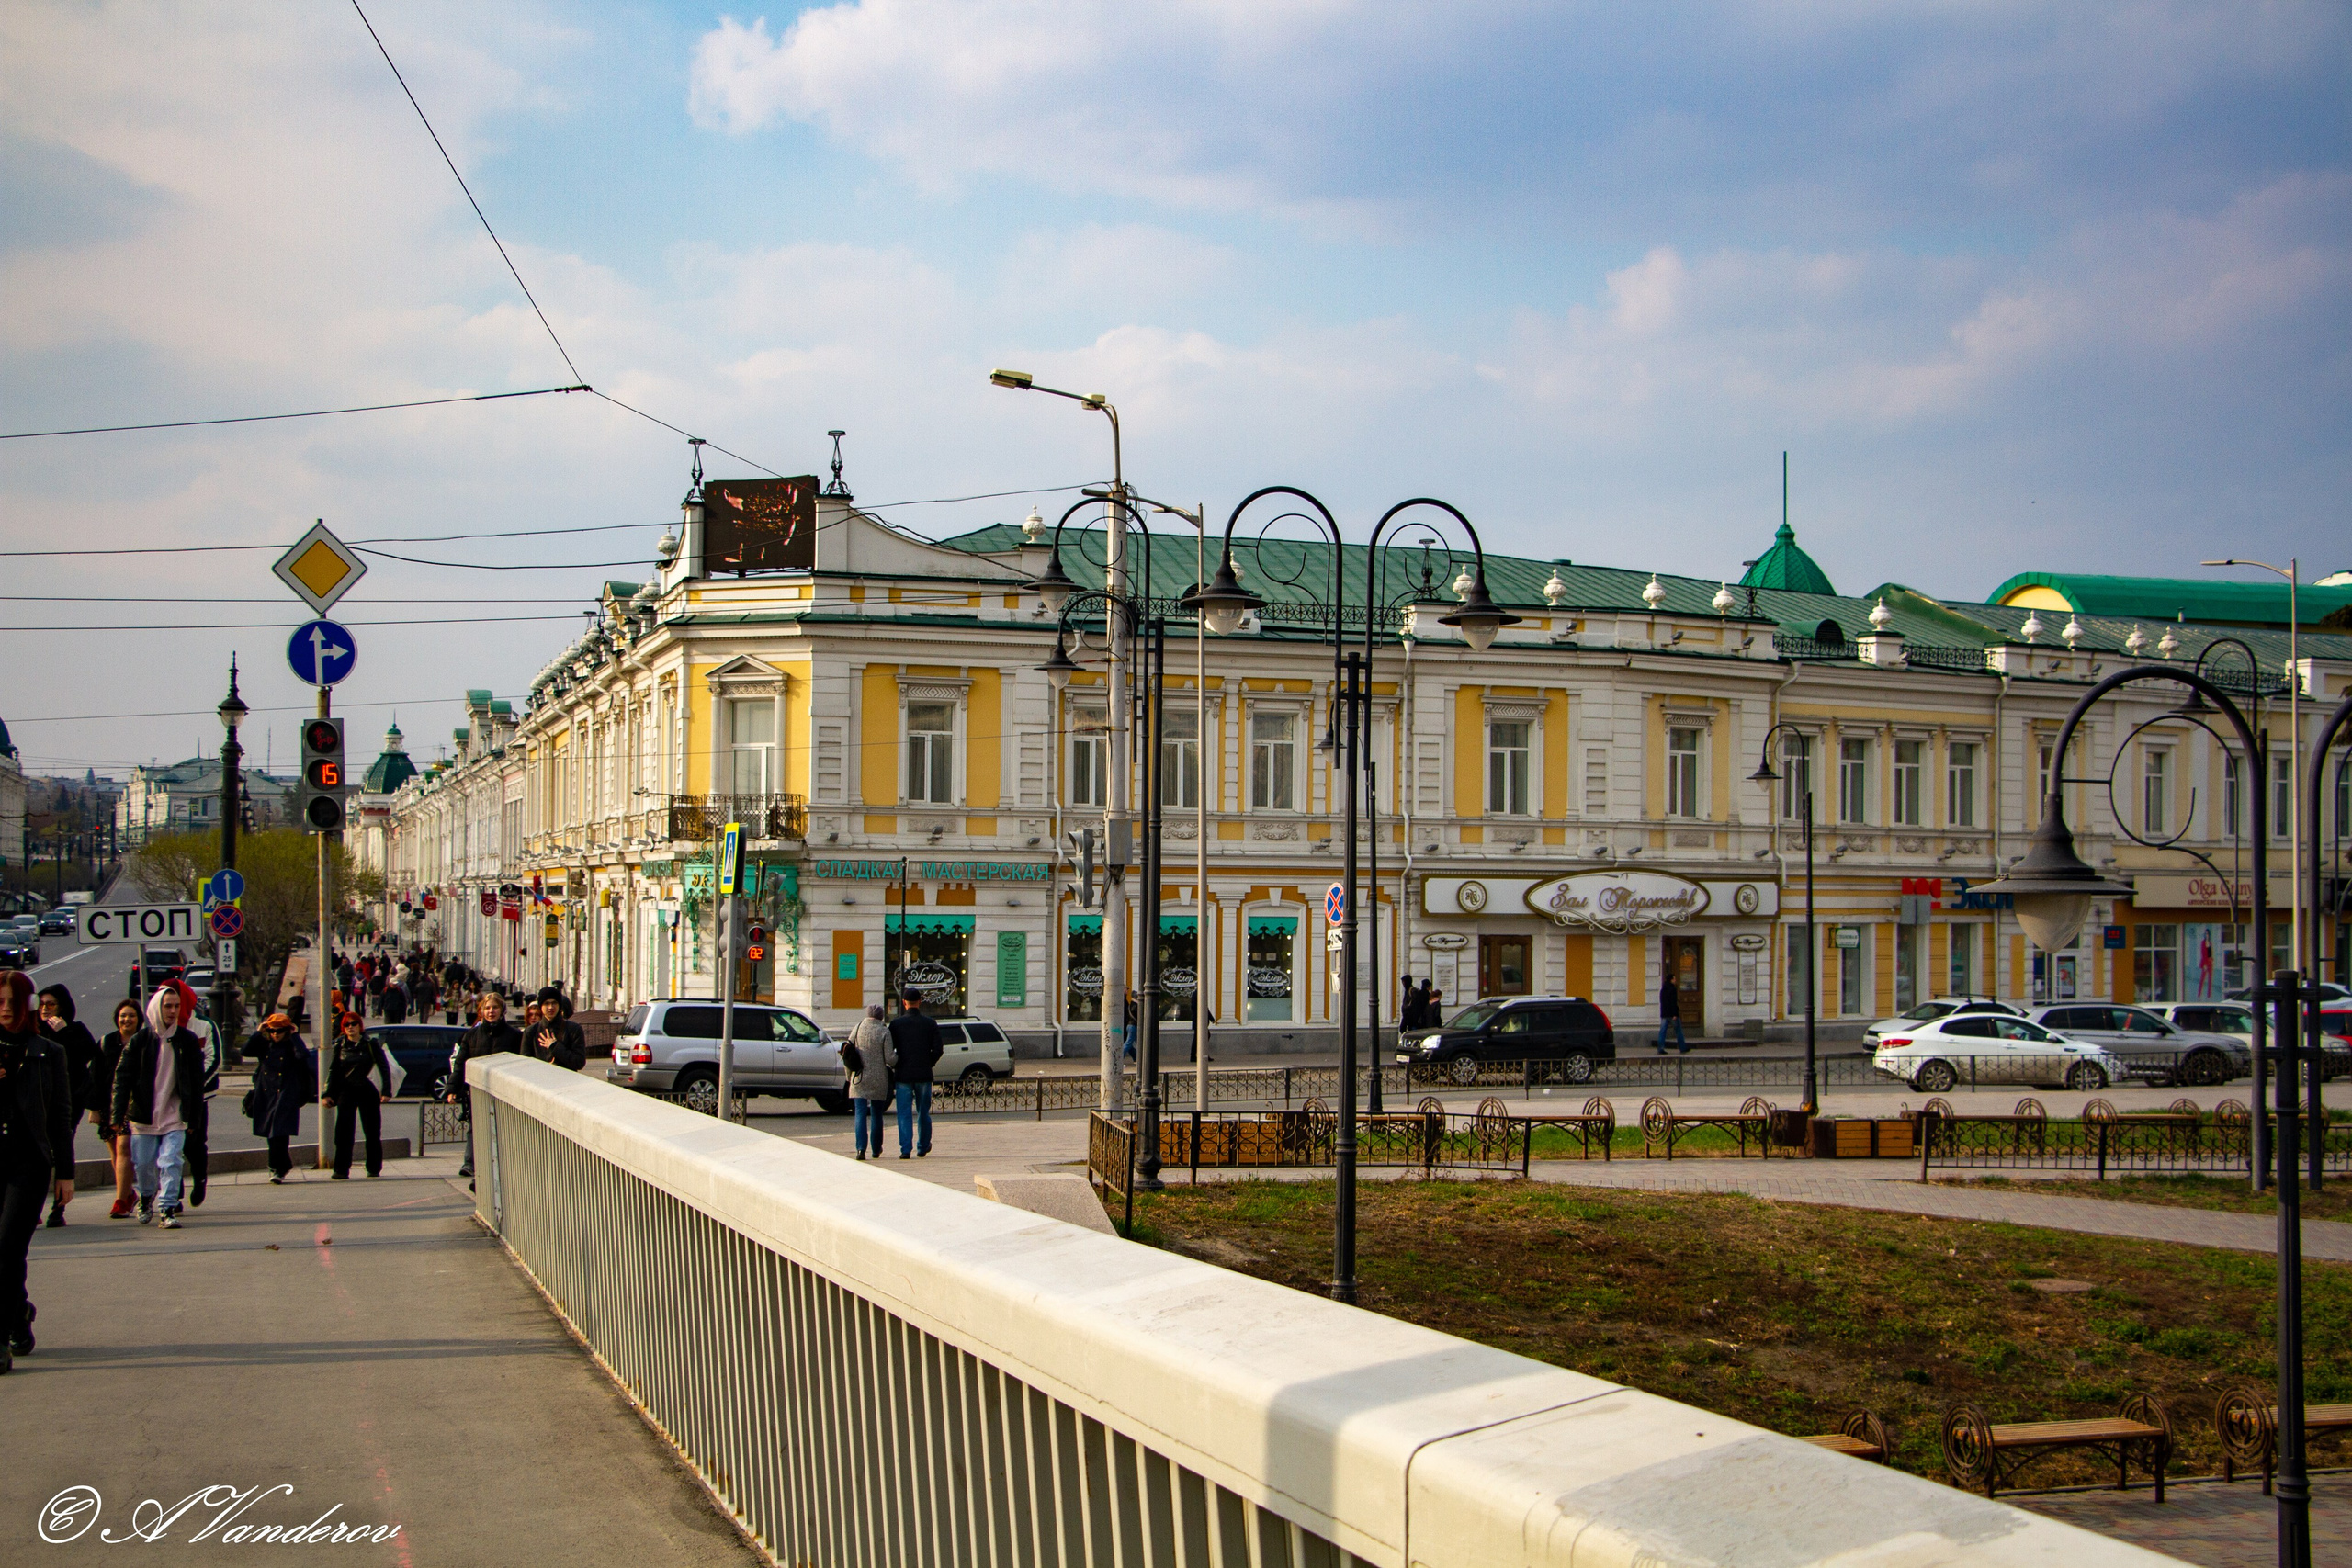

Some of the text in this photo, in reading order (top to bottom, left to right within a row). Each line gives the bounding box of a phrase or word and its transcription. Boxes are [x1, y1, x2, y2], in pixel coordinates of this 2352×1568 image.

[322, 764, 337, 784] 15
[816, 860, 1049, 881] СЛАДКАЯ МАСТЕРСКАЯ
[2188, 878, 2217, 898] Olga
[1550, 883, 1697, 918] Зал Торжеств
[87, 908, 192, 940] СТОП
[750, 947, 763, 960] 82
[908, 967, 944, 984] Эклер
